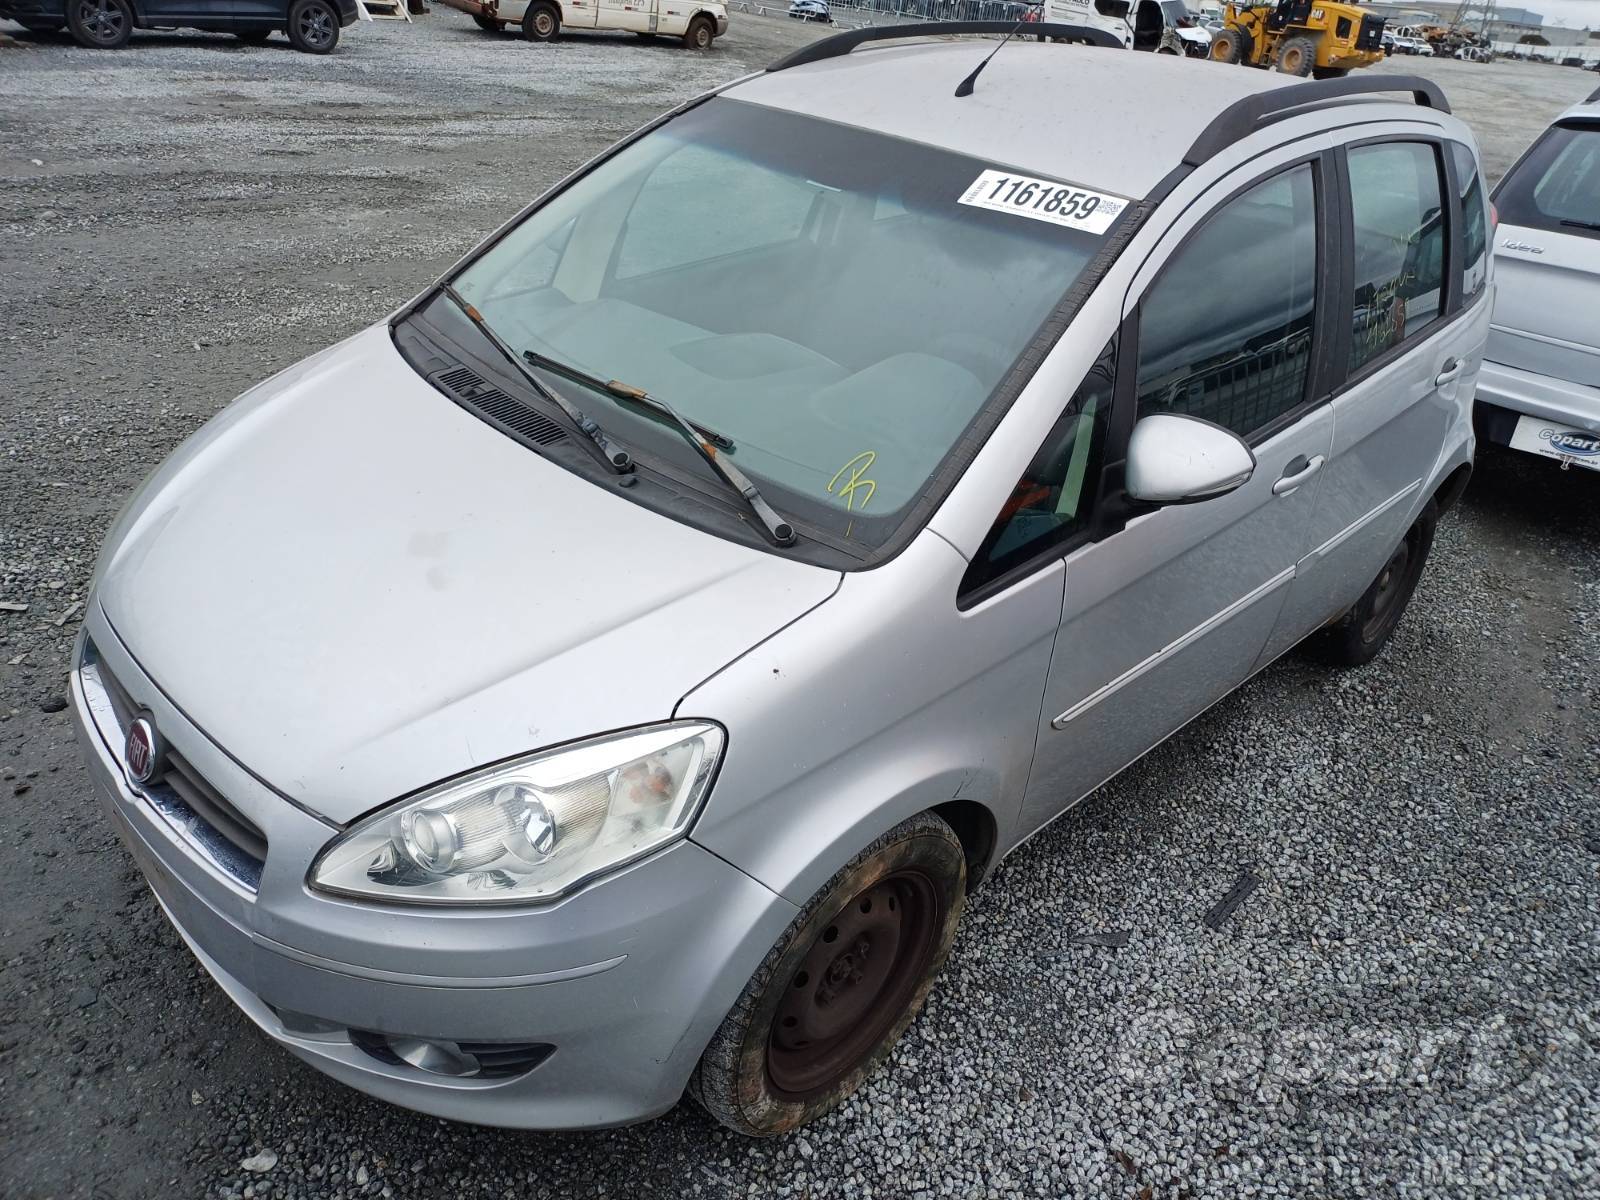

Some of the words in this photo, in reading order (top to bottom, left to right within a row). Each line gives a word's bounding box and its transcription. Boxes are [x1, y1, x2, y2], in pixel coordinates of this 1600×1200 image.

[988, 177, 1101, 220] 1161859
[1539, 428, 1600, 452] Copart
[128, 732, 148, 769] FIAT
